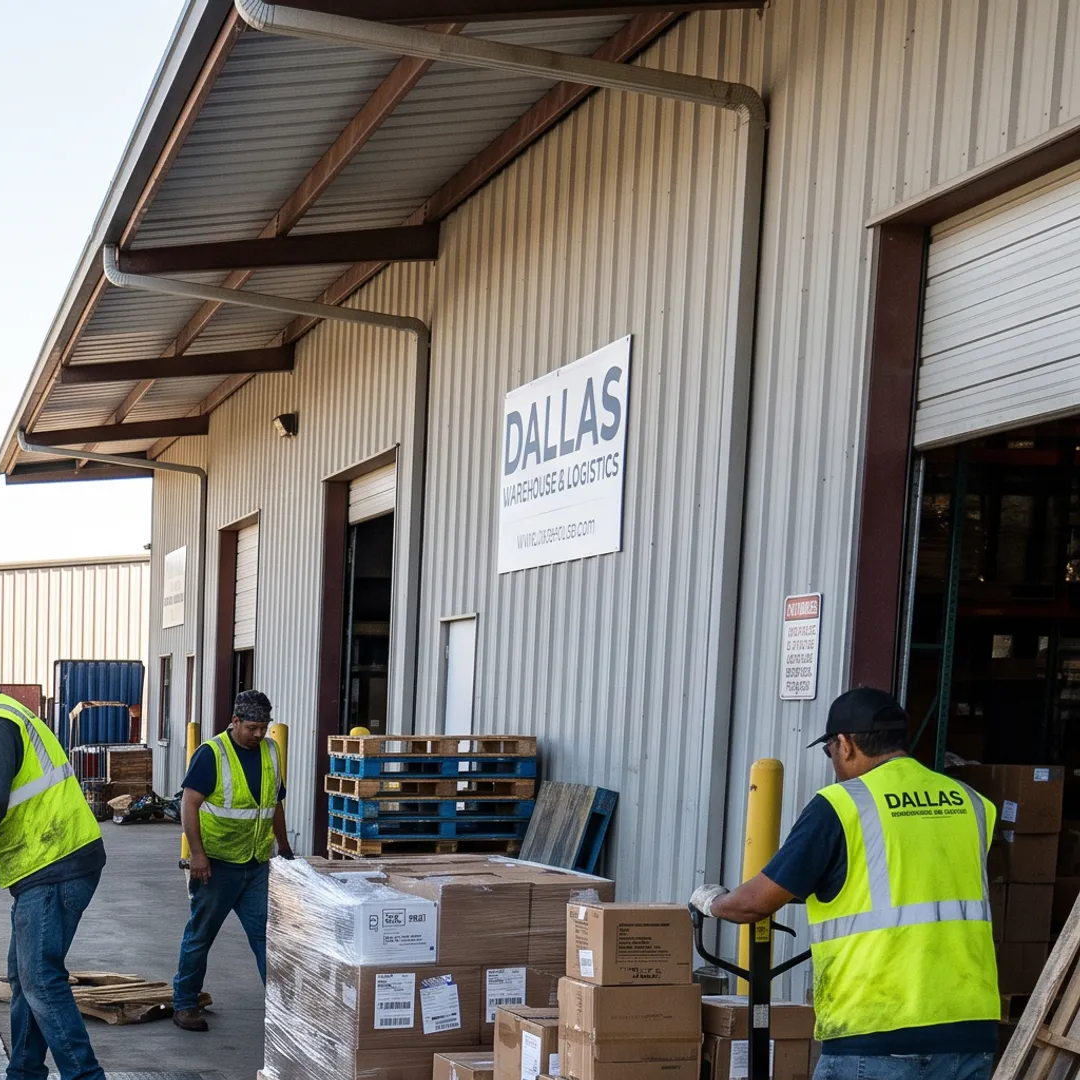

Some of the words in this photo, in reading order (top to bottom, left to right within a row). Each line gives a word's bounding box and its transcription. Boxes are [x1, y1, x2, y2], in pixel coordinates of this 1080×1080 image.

[504, 365, 623, 476] DALLAS
[503, 471, 557, 508] WAREHOUSE
[558, 468, 565, 492] &
[567, 451, 620, 489] LOGISTICS
[884, 790, 964, 809] DALLAS
